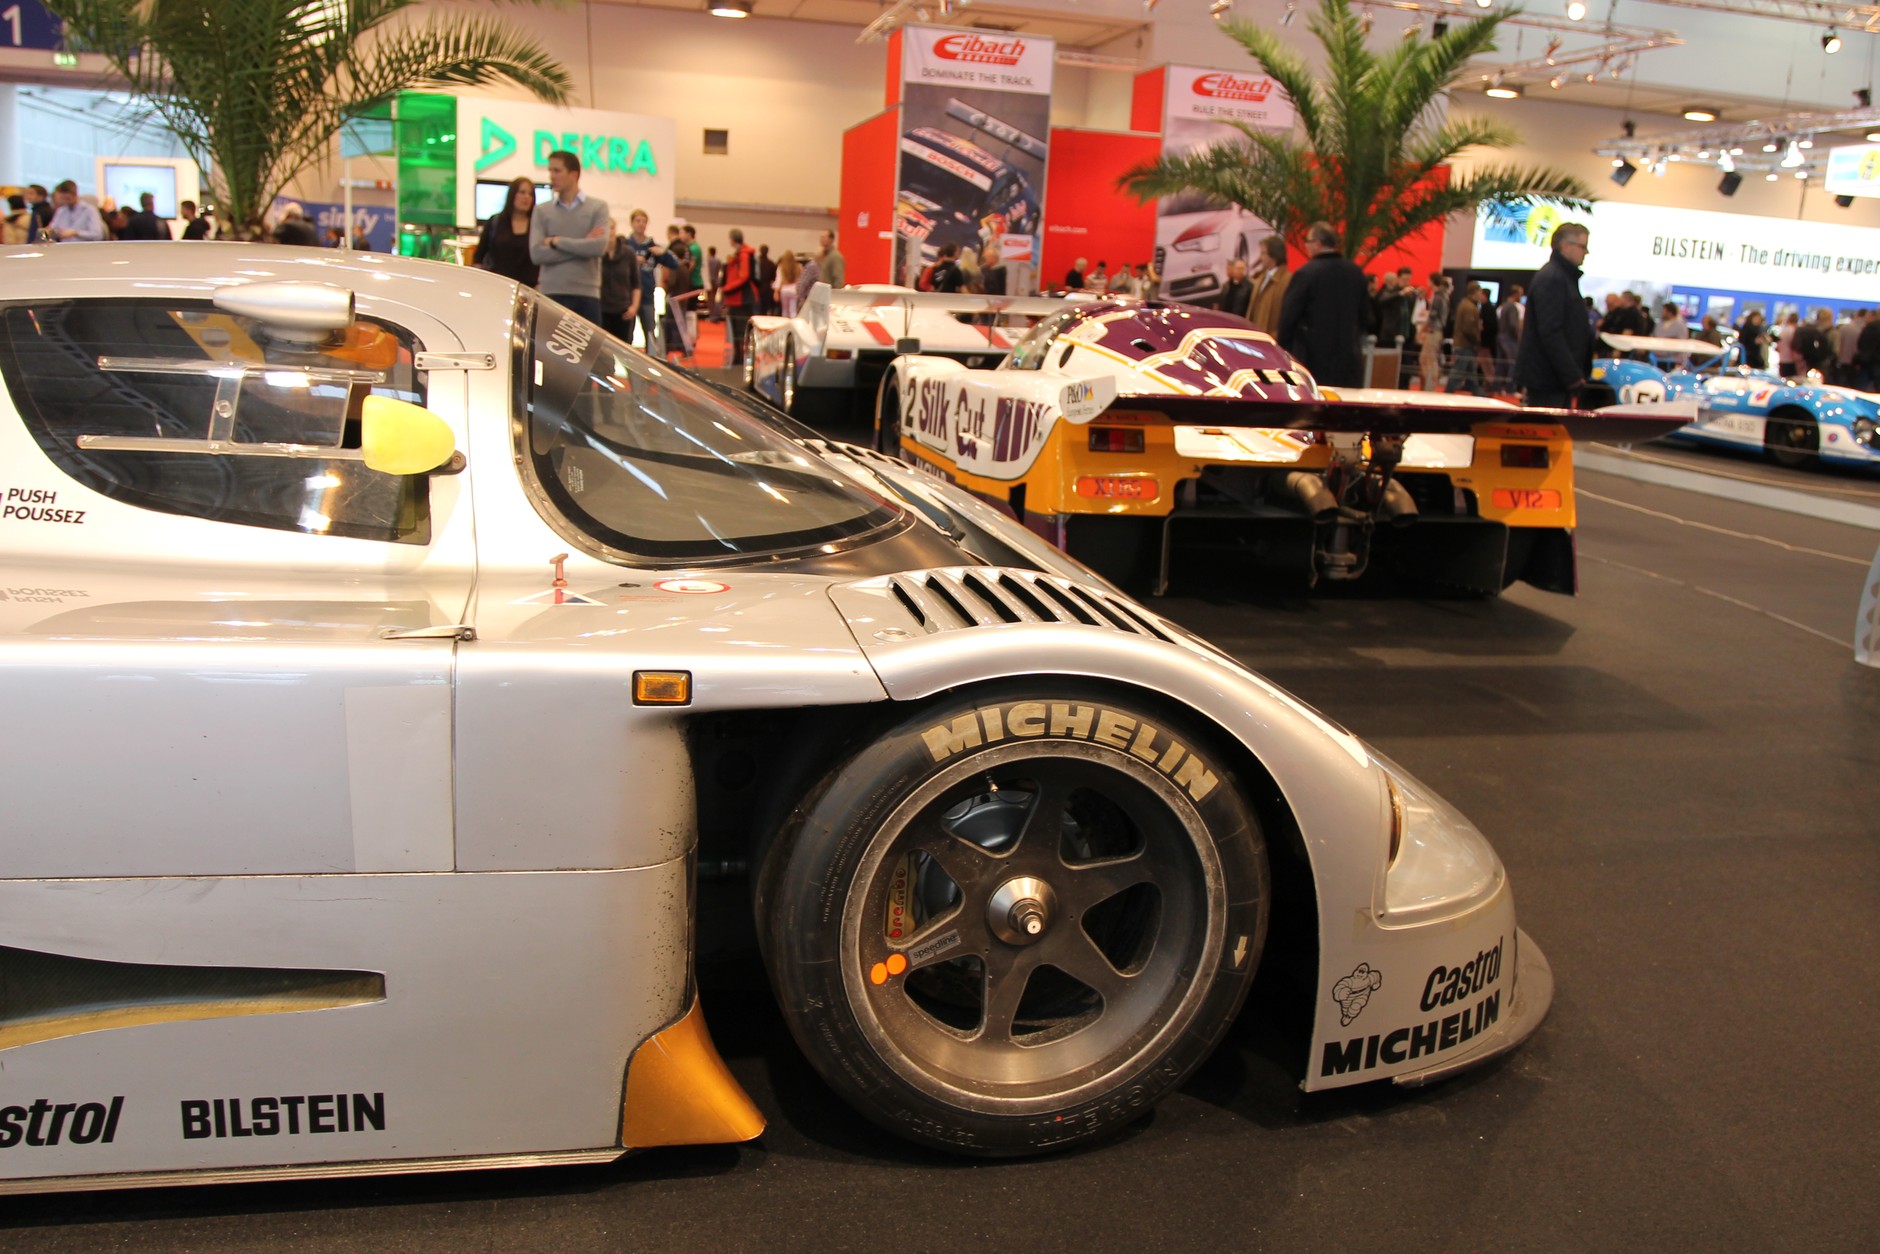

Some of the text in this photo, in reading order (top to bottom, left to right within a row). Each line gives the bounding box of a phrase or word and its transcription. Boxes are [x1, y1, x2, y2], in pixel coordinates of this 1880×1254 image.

[933, 34, 1027, 65] Eibach
[921, 67, 975, 81] DOMINATE
[979, 73, 997, 83] THE
[1192, 73, 1273, 102] Eibach
[1218, 106, 1234, 117] THE
[533, 129, 657, 175] DEKRA
[927, 152, 975, 179] BOSCH
[1652, 236, 1725, 261] BILSTEIN
[1741, 244, 1768, 266] The
[1773, 248, 1831, 273] driving
[904, 378, 986, 460] 2 Silk Cut
[7, 488, 57, 504] PUSH
[1509, 490, 1543, 509] V12
[3, 505, 87, 524] POUSSEZ
[920, 702, 1222, 803] MICHELIN
[912, 935, 956, 959] speedline
[1420, 935, 1503, 1012] Castrol
[1321, 989, 1501, 1077] MICHELIN
[0, 1096, 125, 1148] strol
[180, 1093, 386, 1139] BILSTEIN
